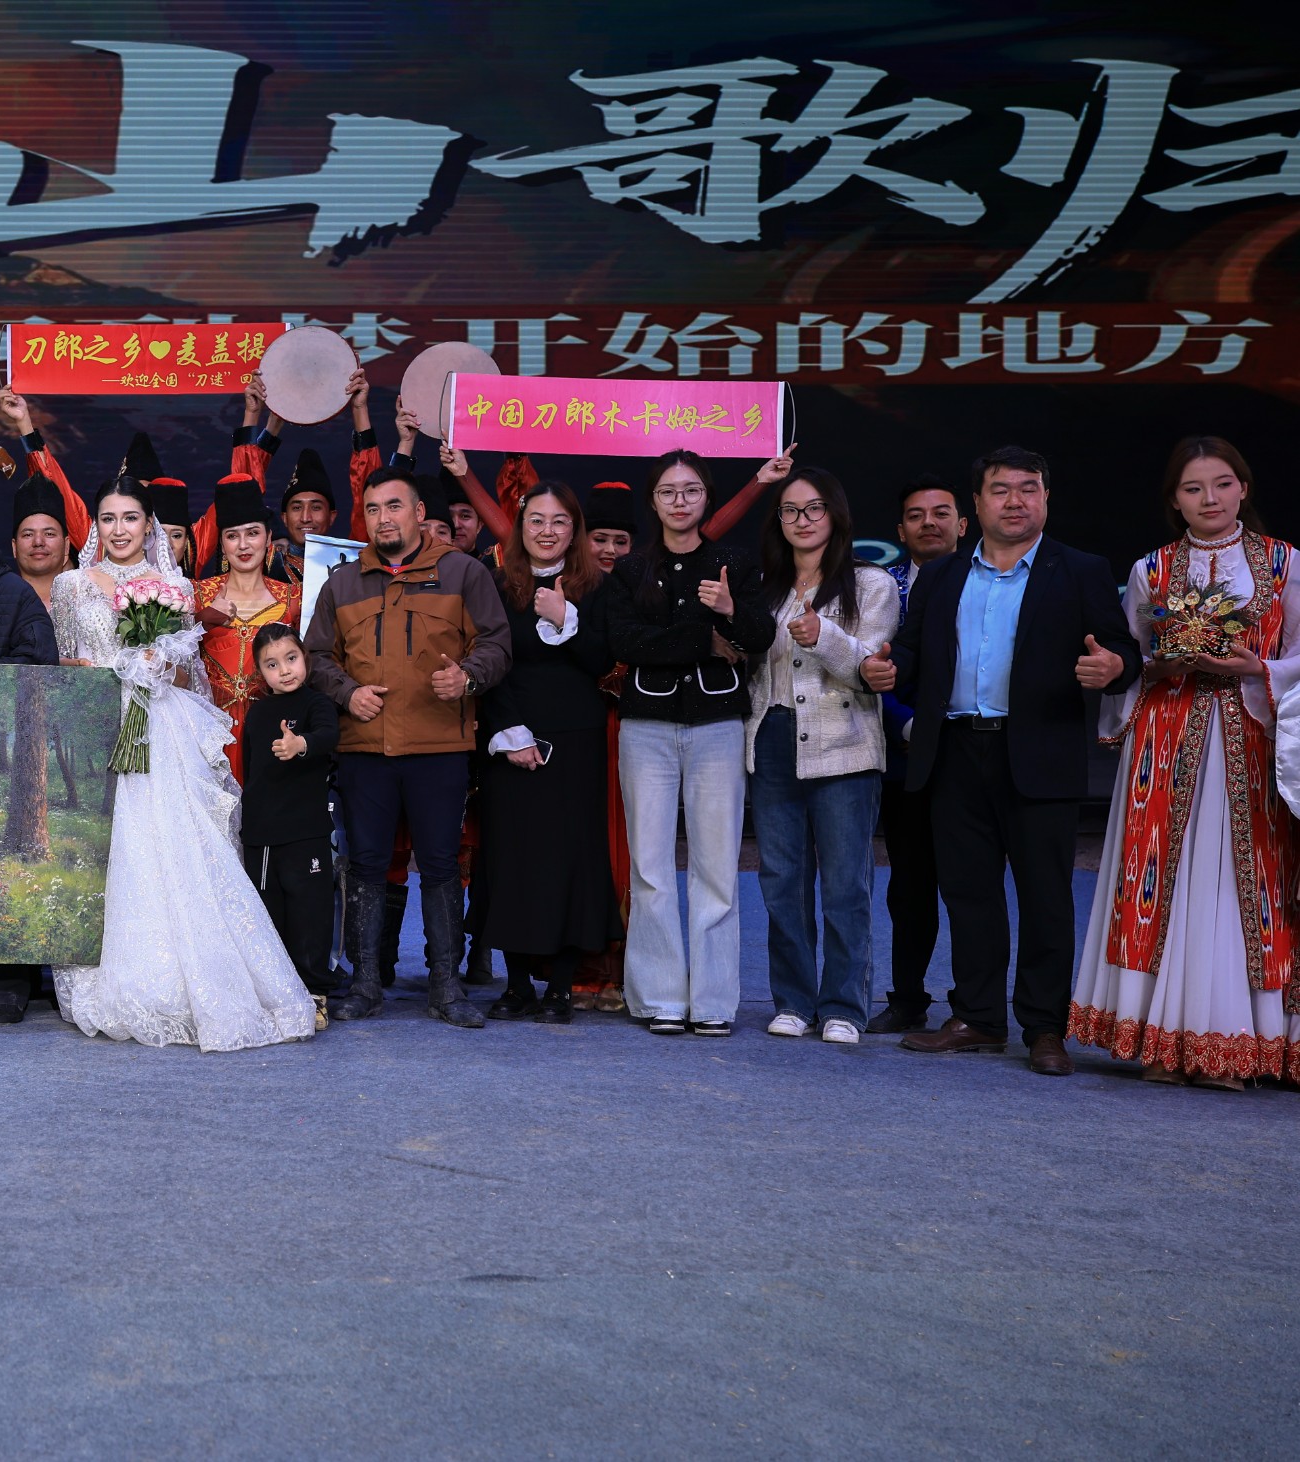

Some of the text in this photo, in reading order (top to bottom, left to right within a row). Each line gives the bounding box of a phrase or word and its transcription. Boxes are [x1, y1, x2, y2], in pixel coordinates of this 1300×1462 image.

[20, 329, 266, 370] 刀郎之乡 麦盖提
[467, 394, 763, 437] 中国刀郎木卡姆之乡
